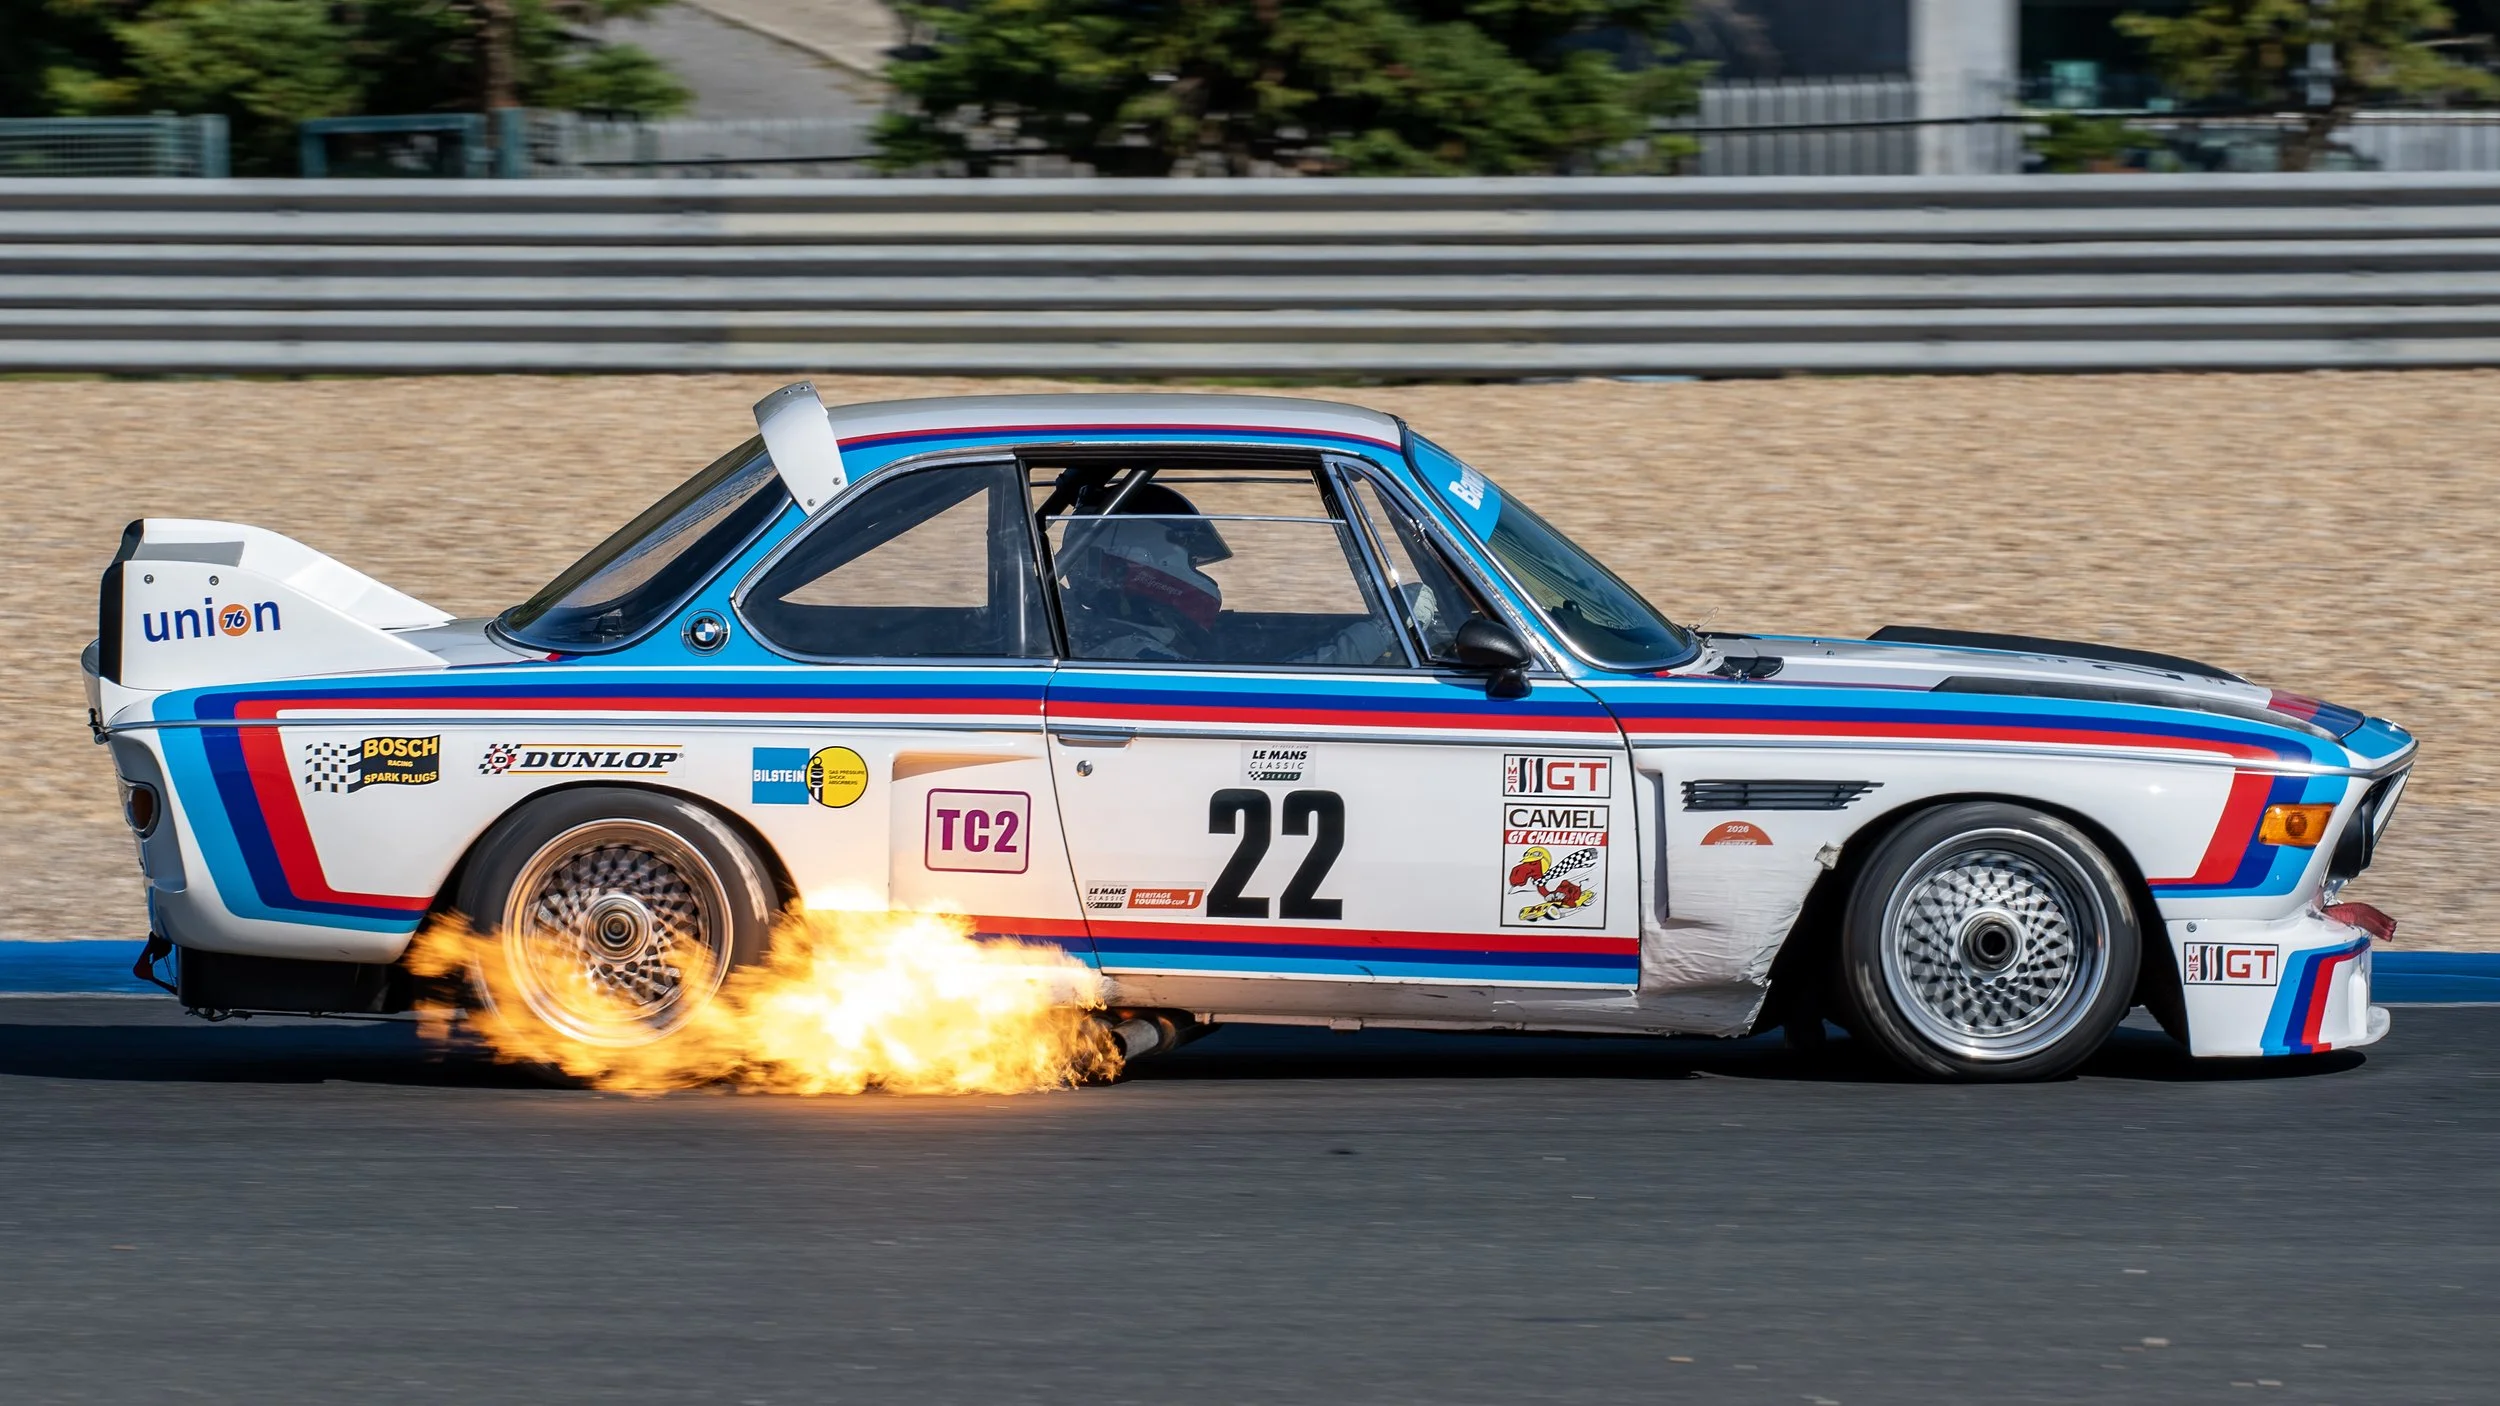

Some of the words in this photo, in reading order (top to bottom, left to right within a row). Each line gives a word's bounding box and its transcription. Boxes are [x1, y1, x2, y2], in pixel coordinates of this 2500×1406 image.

[143, 597, 281, 643] union
[223, 610, 246, 629] 76
[363, 737, 438, 759] BOSCH
[1252, 750, 1267, 760] LE
[1268, 750, 1308, 760] MANS
[520, 751, 679, 769] DUNLOP
[1249, 761, 1305, 770] CLASSIC
[363, 772, 400, 784] SPARK
[401, 771, 437, 783] PLUGS
[753, 769, 805, 783] BILSTEIN
[1507, 757, 1518, 793] IMSA
[1546, 762, 1608, 792] GT
[1508, 808, 1605, 829] CAMEL
[936, 808, 1019, 853] TC2
[1507, 830, 1527, 844] GT
[1527, 830, 1604, 845] CHALLENGE
[1206, 787, 1345, 920] 22
[1089, 887, 1099, 895] LE
[1100, 887, 1127, 895] MANS
[1187, 891, 1196, 906] 1
[2188, 945, 2199, 981] IMSA
[2226, 949, 2276, 979] GT
